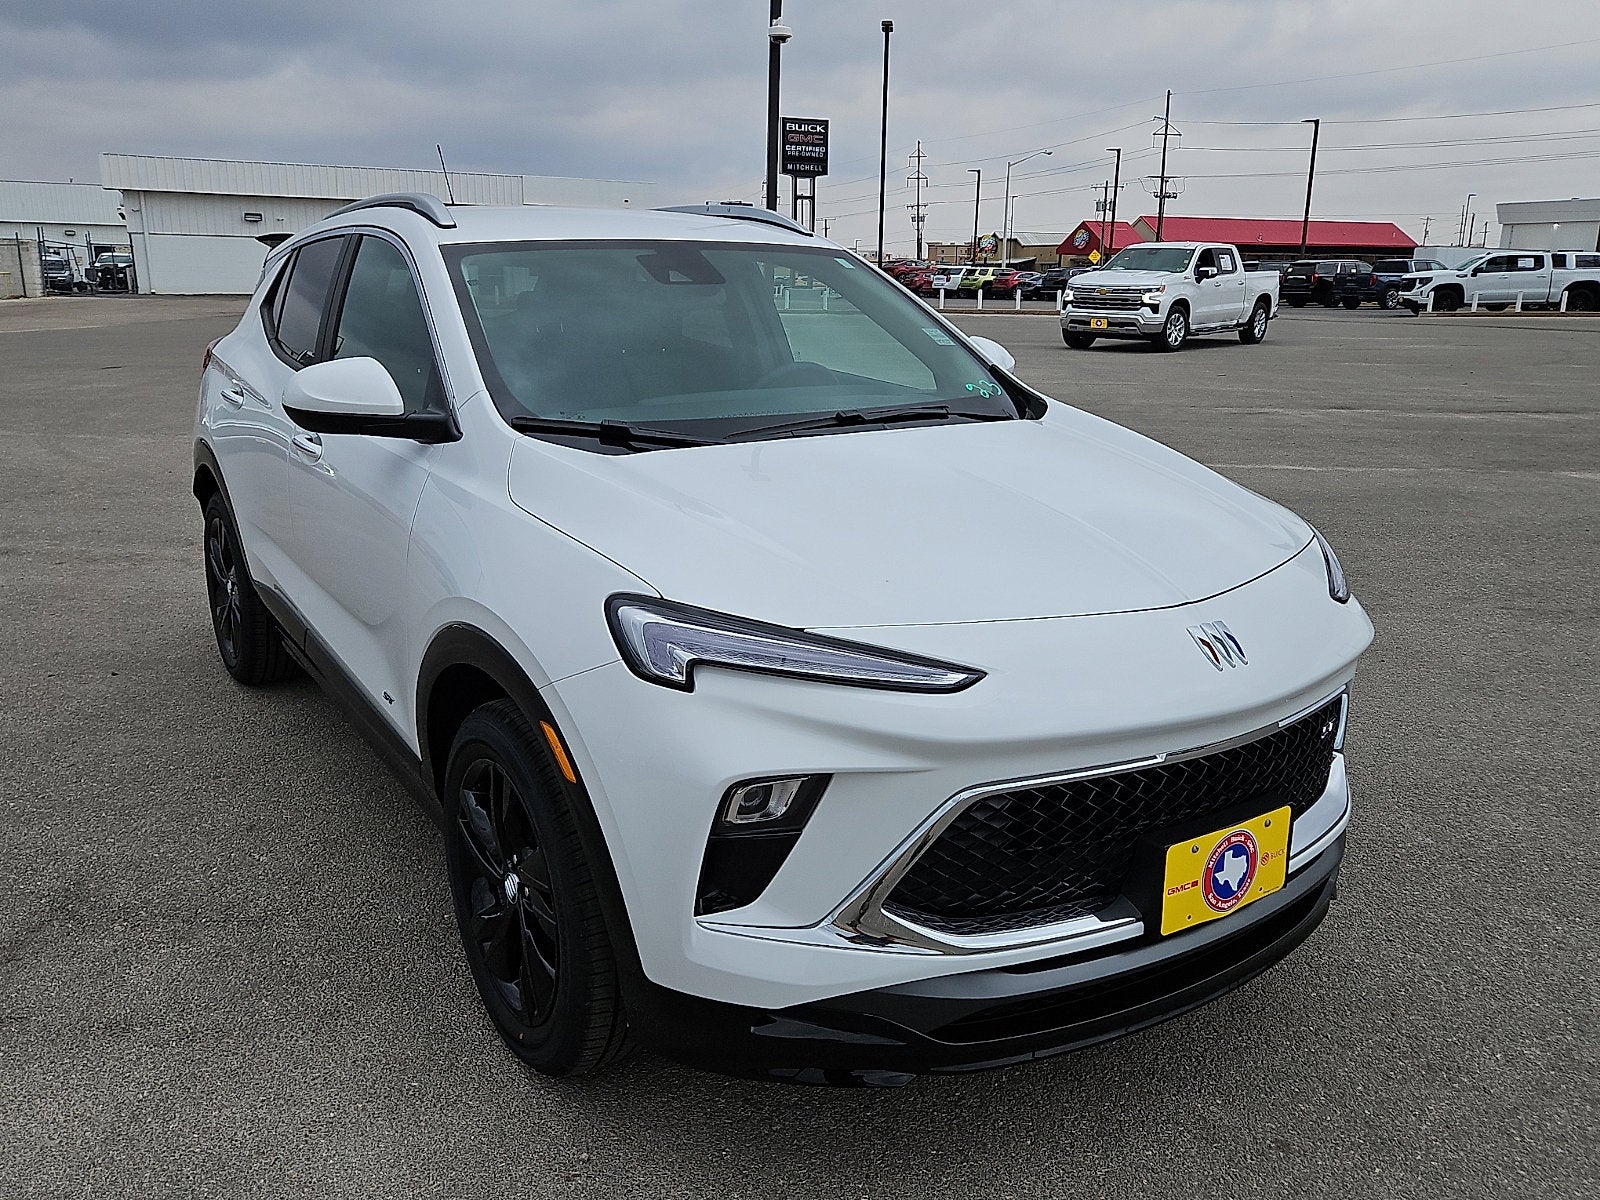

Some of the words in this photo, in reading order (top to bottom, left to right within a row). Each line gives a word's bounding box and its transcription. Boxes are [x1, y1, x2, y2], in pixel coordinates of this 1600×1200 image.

[786, 123, 825, 132] BUICK
[787, 134, 823, 143] GMC
[965, 379, 1002, 399] 23
[1208, 840, 1229, 868] Mitchell
[1167, 882, 1190, 895] GMC
[1208, 892, 1217, 905] San
